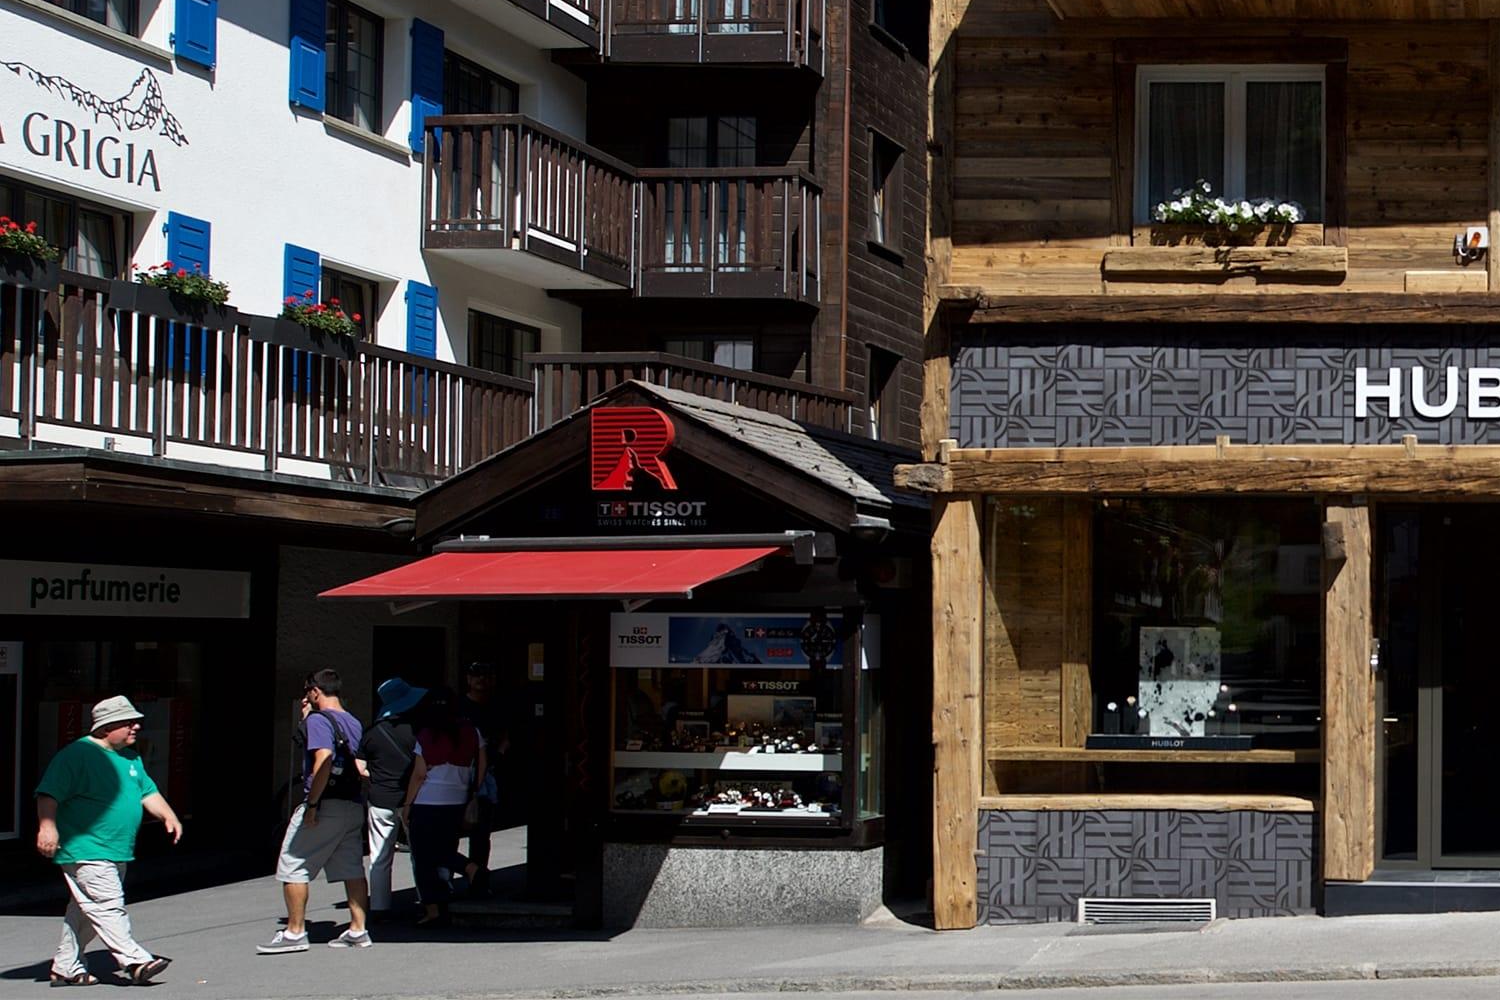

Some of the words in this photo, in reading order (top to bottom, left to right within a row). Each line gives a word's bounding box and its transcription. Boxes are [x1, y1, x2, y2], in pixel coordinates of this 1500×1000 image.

[22, 112, 161, 192] GRIGIA
[628, 501, 707, 517] TISSOT
[30, 569, 181, 608] parfumerie
[618, 635, 662, 645] TISSOT
[757, 681, 800, 690] TISSOT
